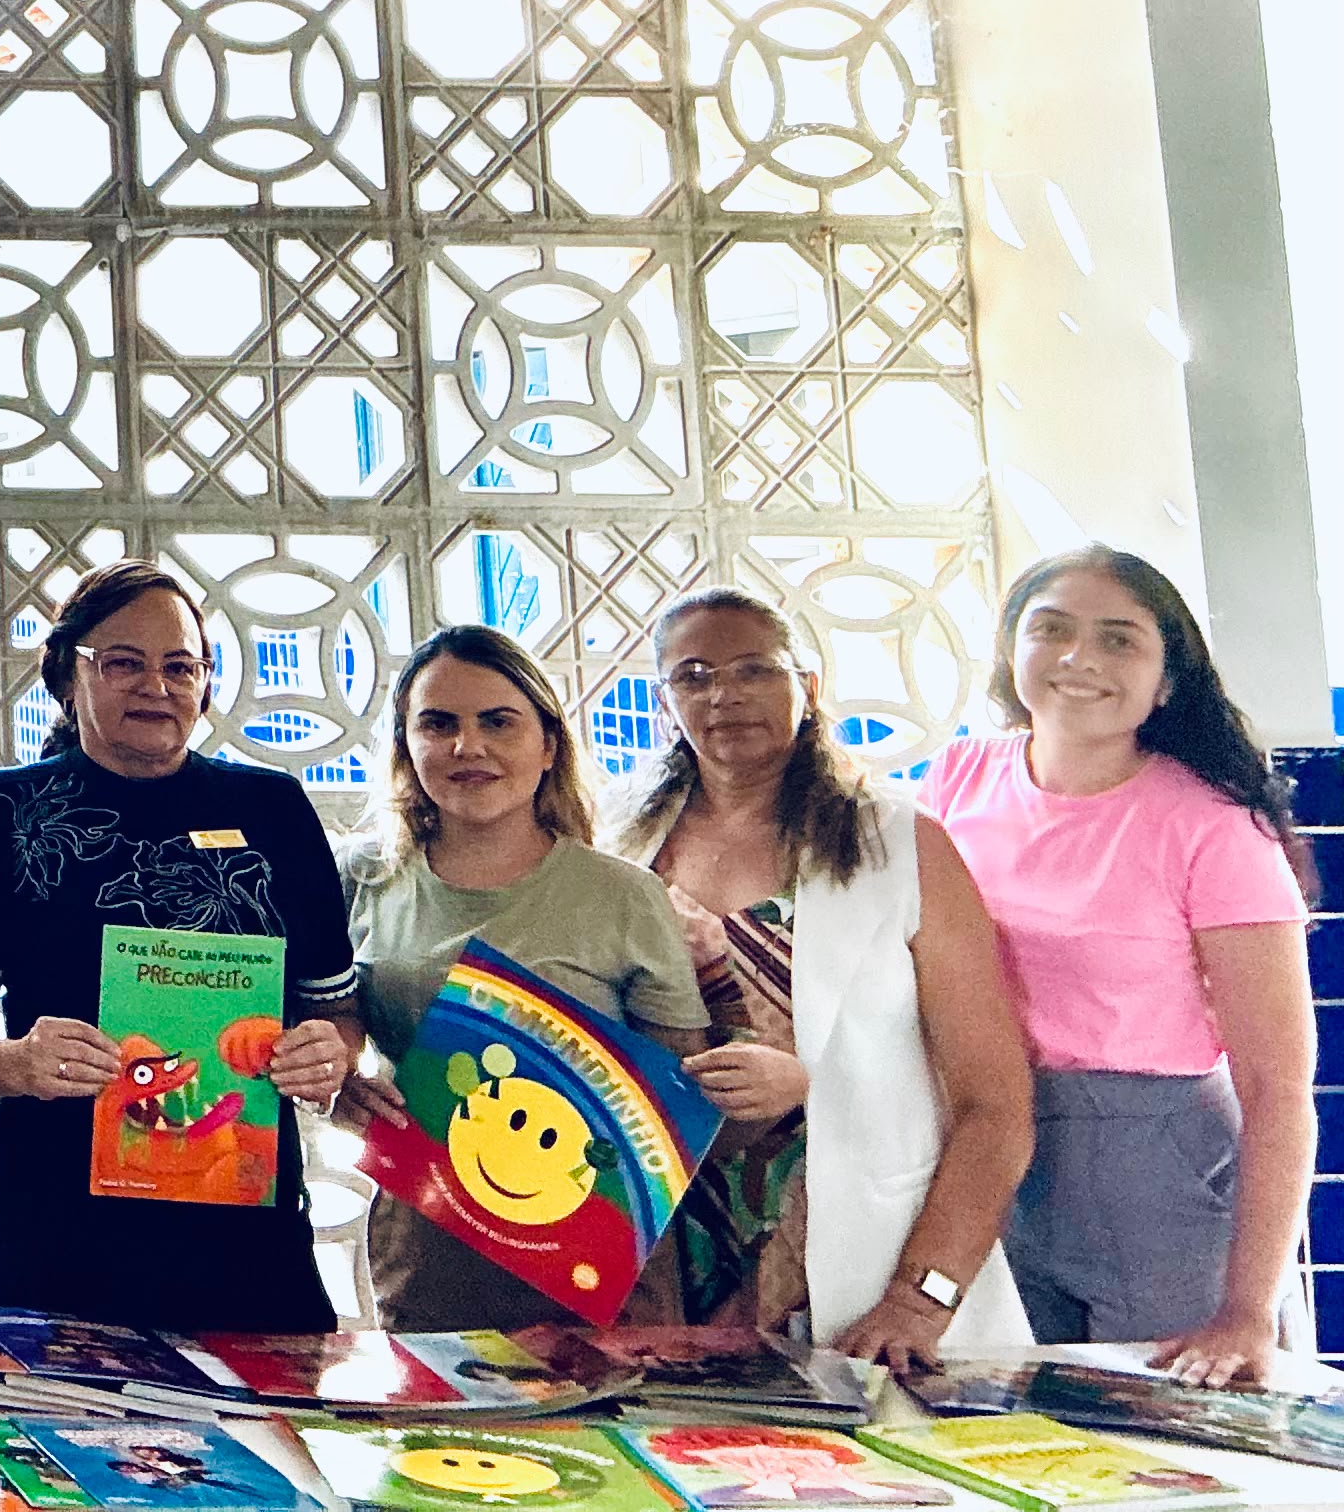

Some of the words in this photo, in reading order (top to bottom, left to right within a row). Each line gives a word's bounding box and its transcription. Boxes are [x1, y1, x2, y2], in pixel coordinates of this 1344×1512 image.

[116, 941, 127, 954] O
[128, 943, 149, 957] QUE
[151, 939, 177, 959] NÃO
[177, 949, 204, 961] CABE
[217, 951, 240, 963] MEU
[136, 962, 254, 990] PRECONCEITO
[505, 1001, 671, 1174] MUNDINHO
